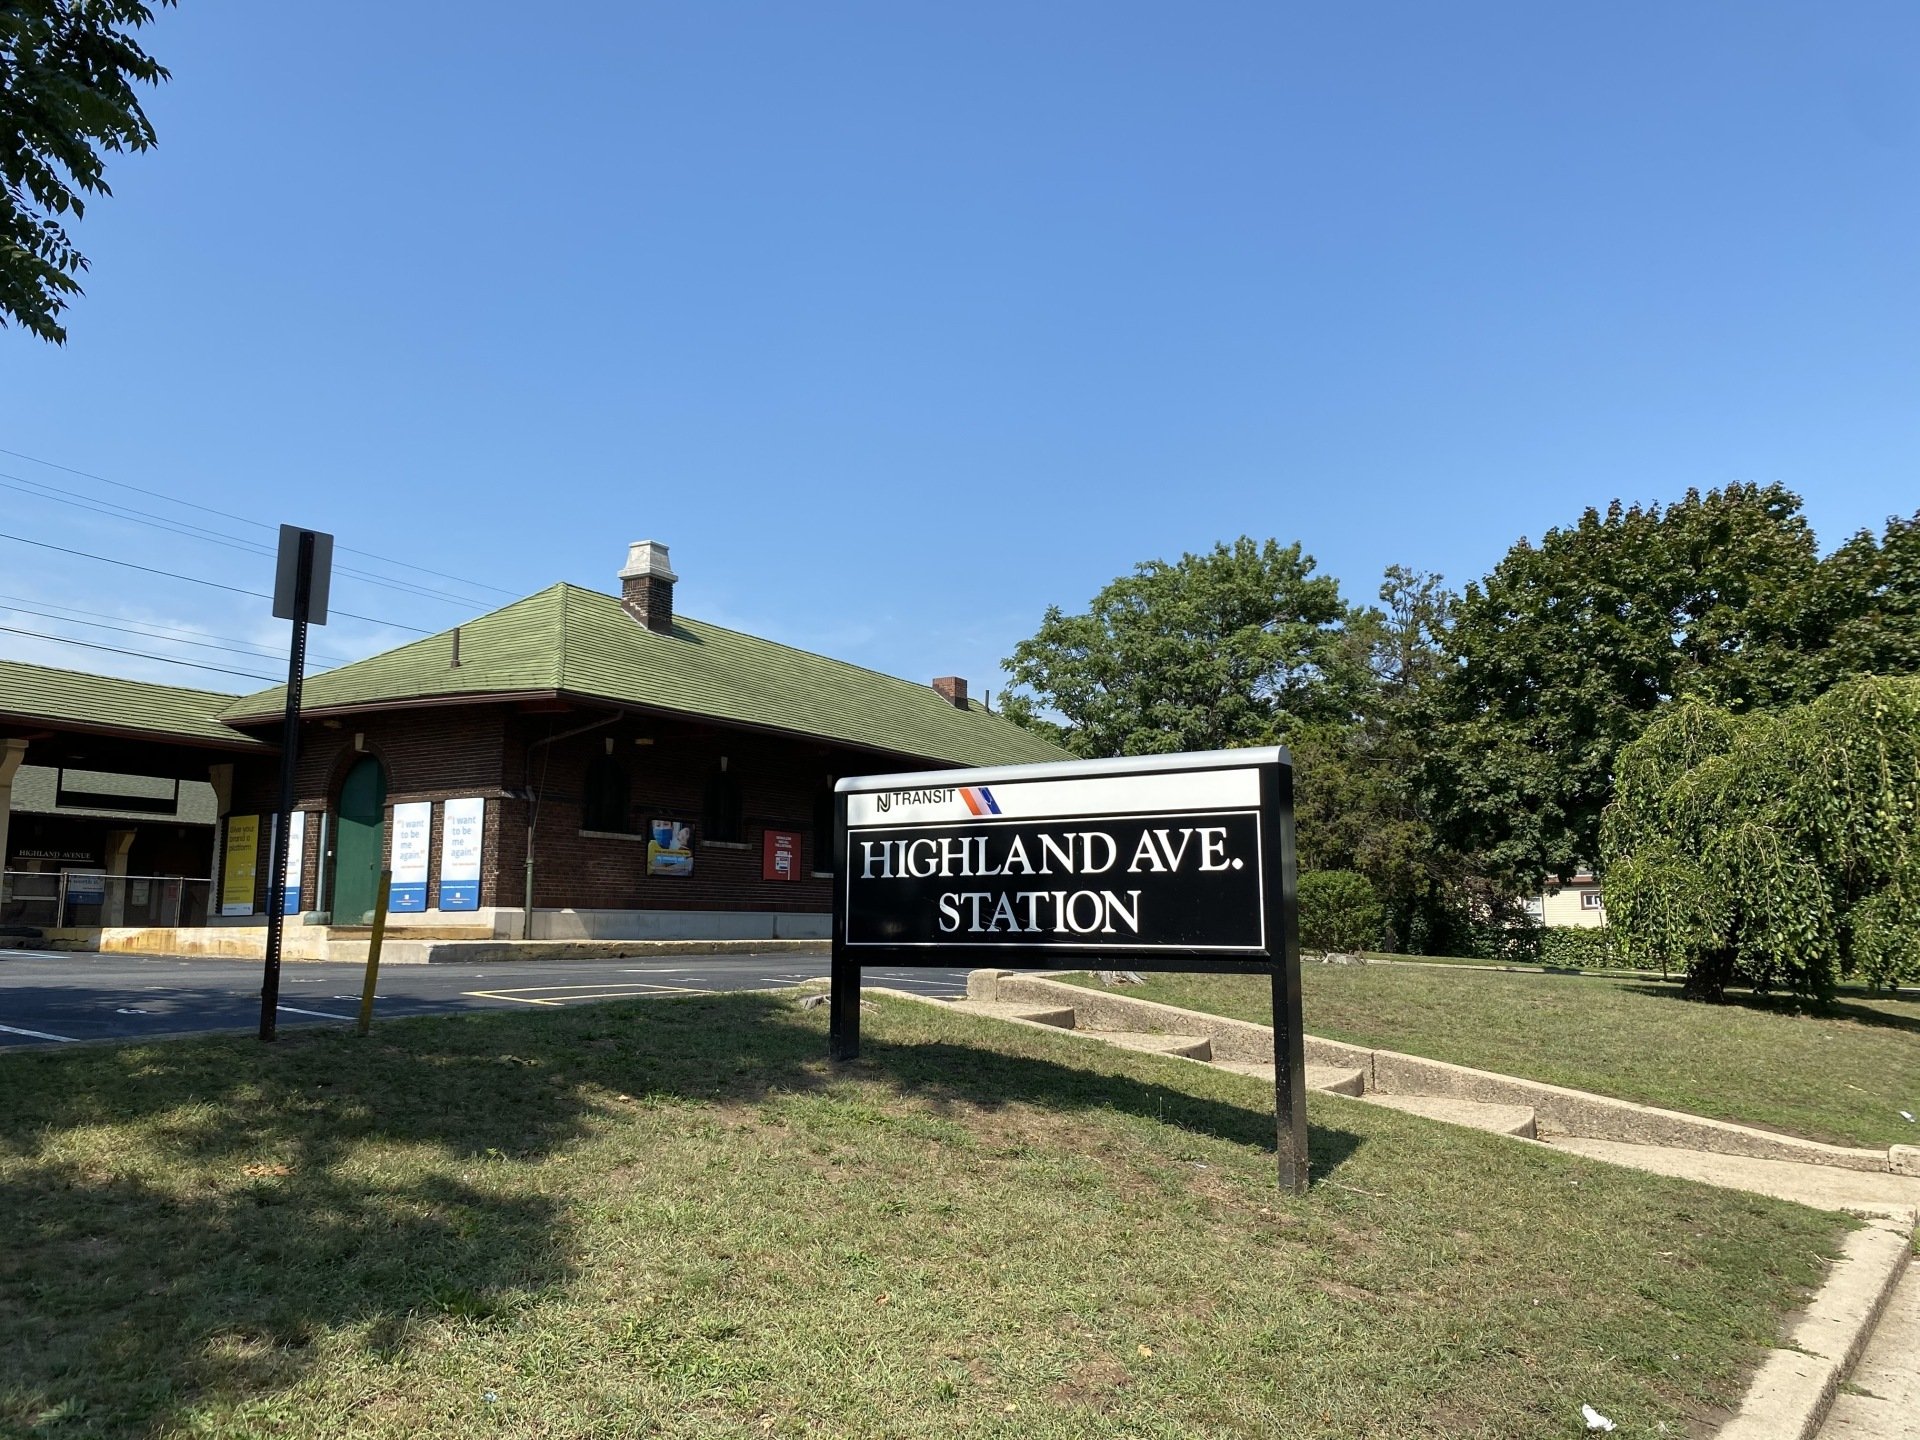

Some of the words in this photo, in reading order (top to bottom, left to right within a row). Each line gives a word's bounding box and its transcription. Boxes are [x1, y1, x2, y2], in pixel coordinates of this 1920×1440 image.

[893, 788, 956, 806] TRANSIT
[406, 820, 424, 828] want
[457, 816, 476, 824] want
[411, 830, 419, 838] be
[452, 827, 460, 835] to
[462, 827, 471, 835] be
[452, 838, 464, 846] me
[19, 850, 60, 858] HIGHLAND
[63, 851, 91, 859] AVENUE
[860, 832, 1117, 879] HIGHLAND
[1127, 827, 1244, 873] AVE.
[938, 890, 1142, 934] STATION
